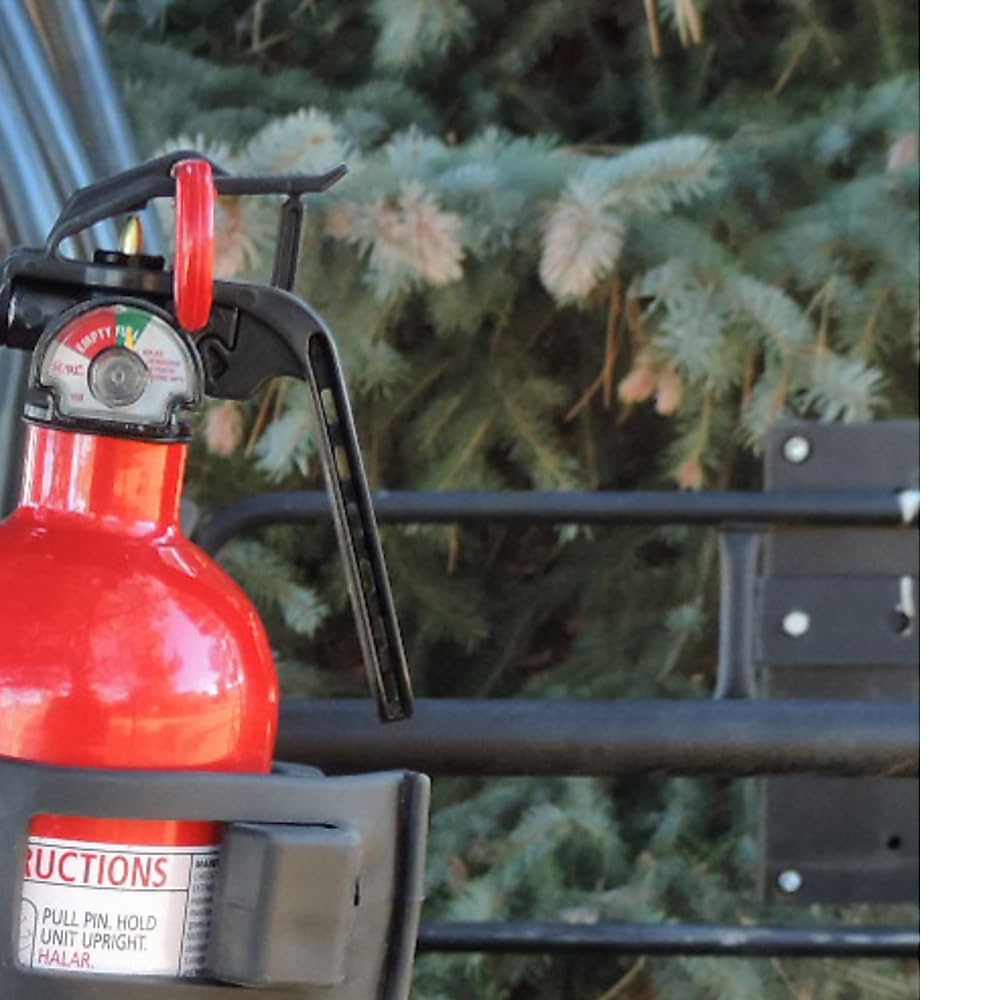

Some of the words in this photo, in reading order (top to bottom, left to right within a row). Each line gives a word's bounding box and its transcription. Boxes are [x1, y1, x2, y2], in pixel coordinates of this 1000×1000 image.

[76, 326, 113, 353] EMPTY
[116, 324, 140, 347] FUL
[42, 907, 79, 926] PULL
[83, 911, 112, 930] PIN.
[117, 914, 157, 931] HOLD
[40, 929, 78, 948] UNIT
[82, 932, 147, 951] UPRIGHT.
[38, 950, 94, 969] HALAR.
